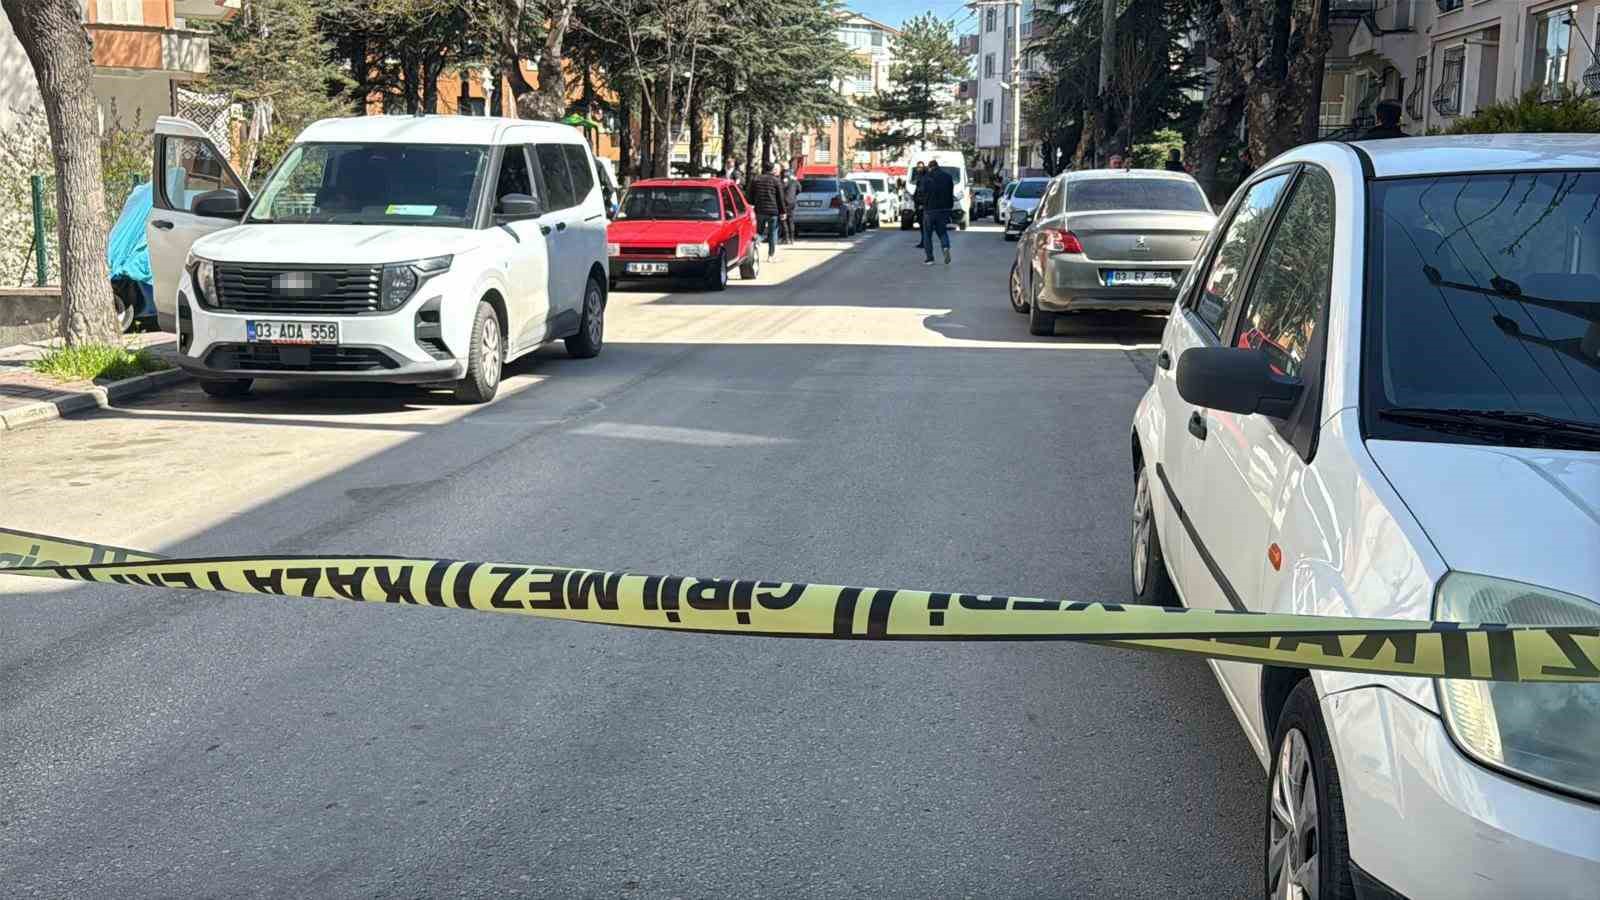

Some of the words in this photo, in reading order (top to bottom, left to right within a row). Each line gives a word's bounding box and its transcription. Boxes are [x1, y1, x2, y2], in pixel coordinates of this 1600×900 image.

[255, 322, 272, 338] 03
[311, 324, 337, 340] 558
[243, 565, 419, 605] KAZA
